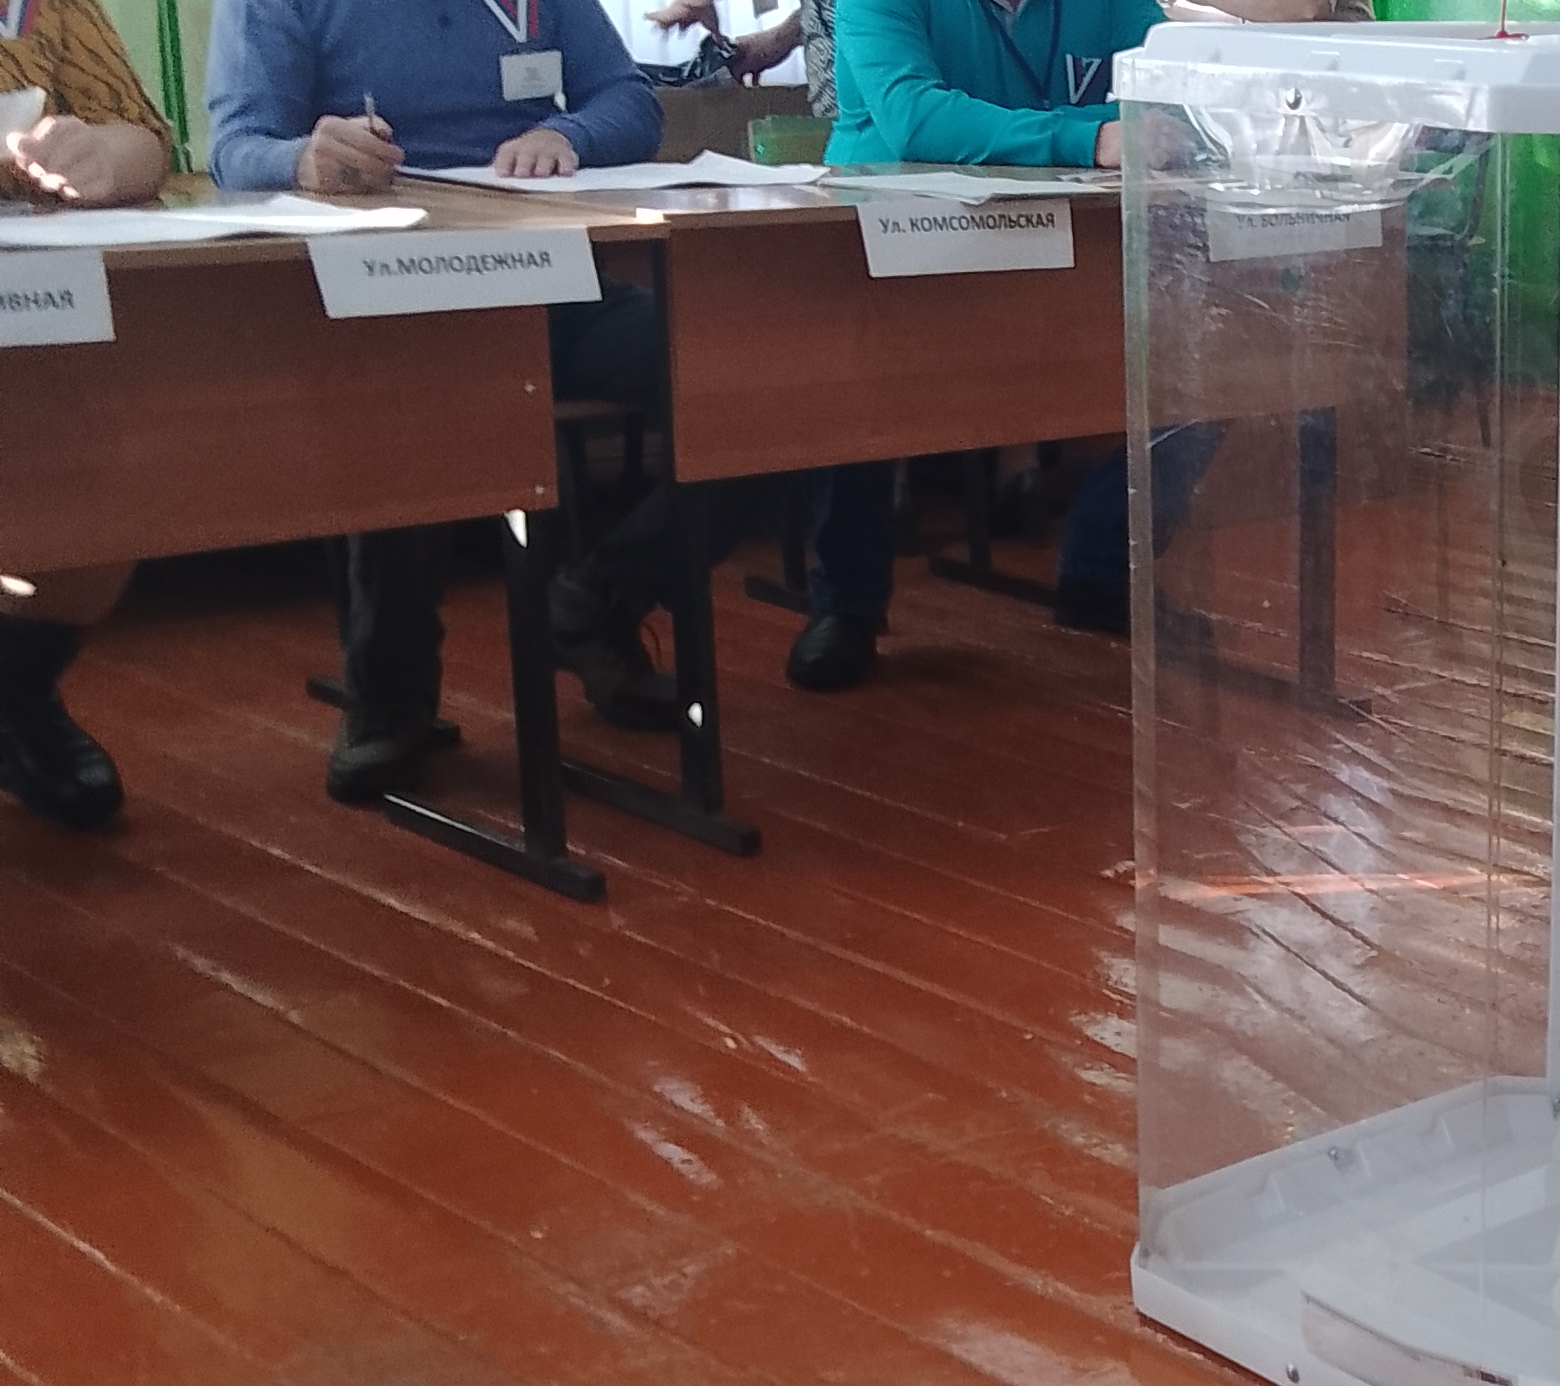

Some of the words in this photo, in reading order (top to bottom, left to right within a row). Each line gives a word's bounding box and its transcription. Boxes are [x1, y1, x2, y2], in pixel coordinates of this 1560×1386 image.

[878, 217, 907, 235] Ул.
[909, 212, 1056, 234] КОМСОМОЛЬСКАЯ
[362, 250, 553, 278] Ул.МОЛОДЕЖНАЯ
